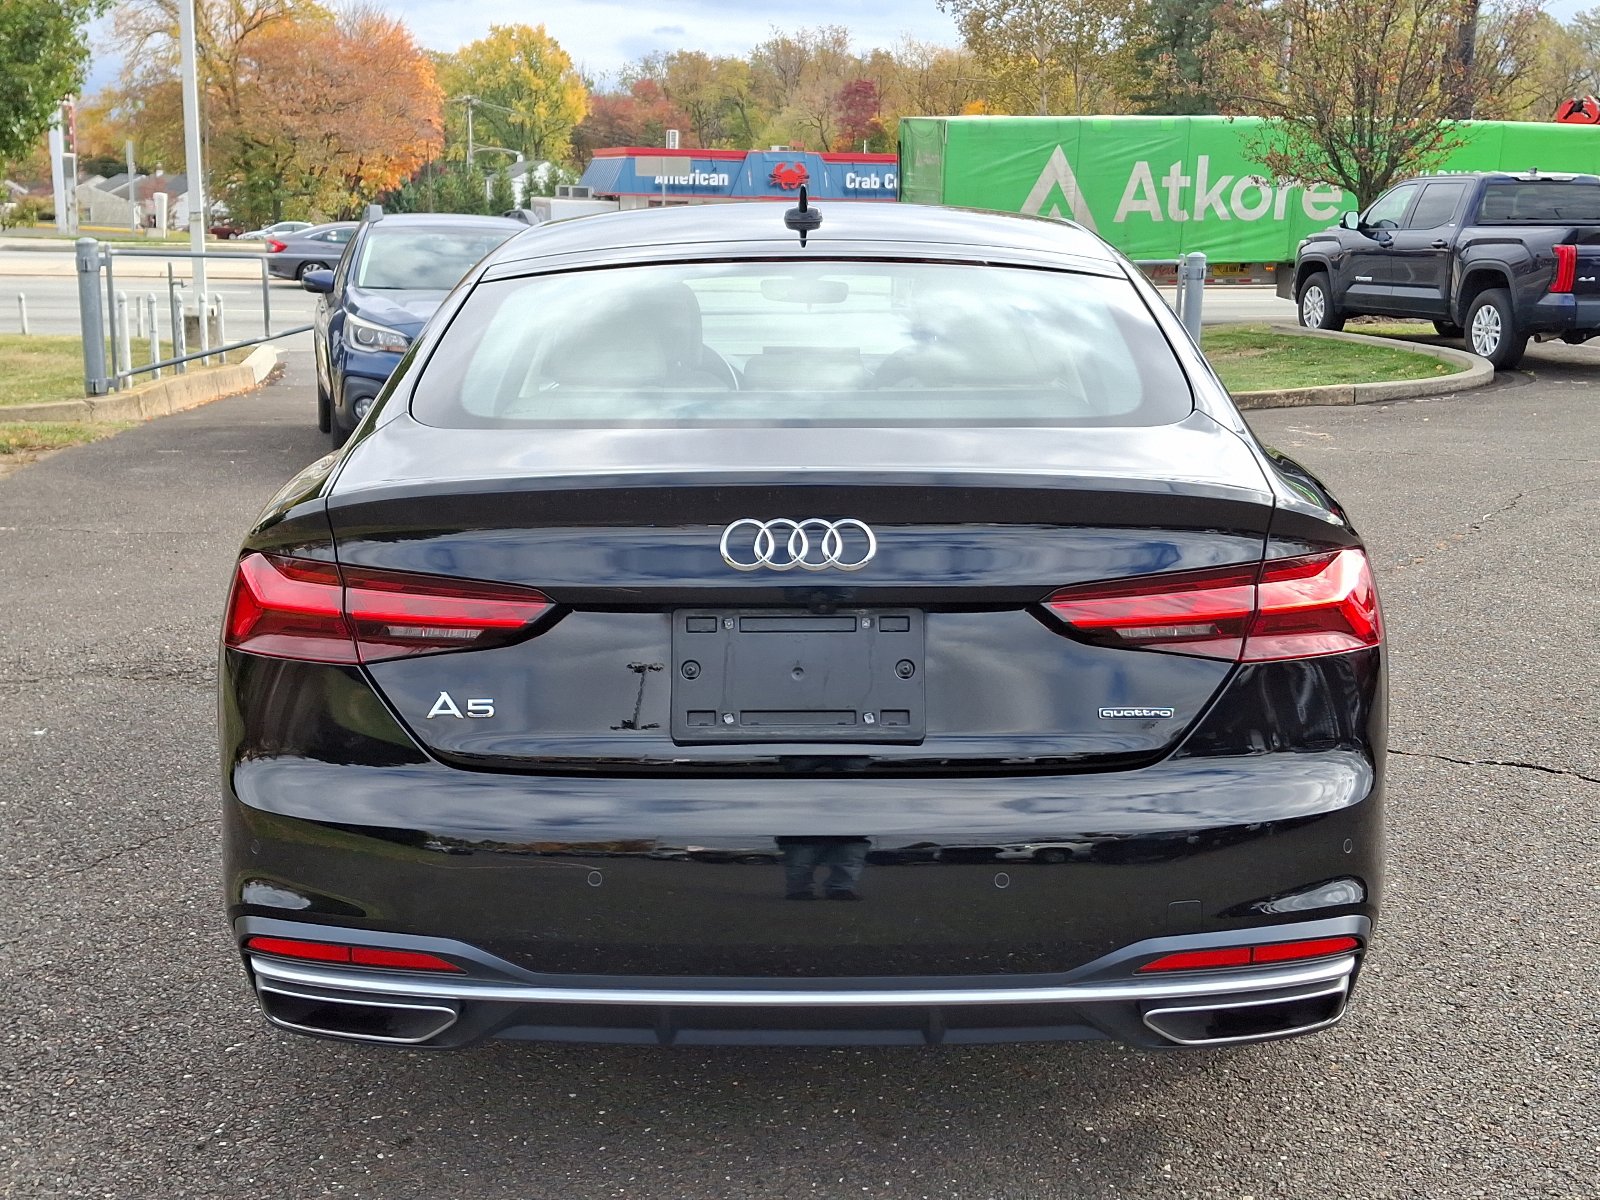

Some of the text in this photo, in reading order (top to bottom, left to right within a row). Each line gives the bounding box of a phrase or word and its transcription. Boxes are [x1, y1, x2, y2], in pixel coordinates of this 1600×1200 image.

[845, 172, 880, 189] Crab
[1112, 154, 1343, 223] Atkore
[426, 691, 495, 719] A5
[1102, 709, 1172, 718] quattro
